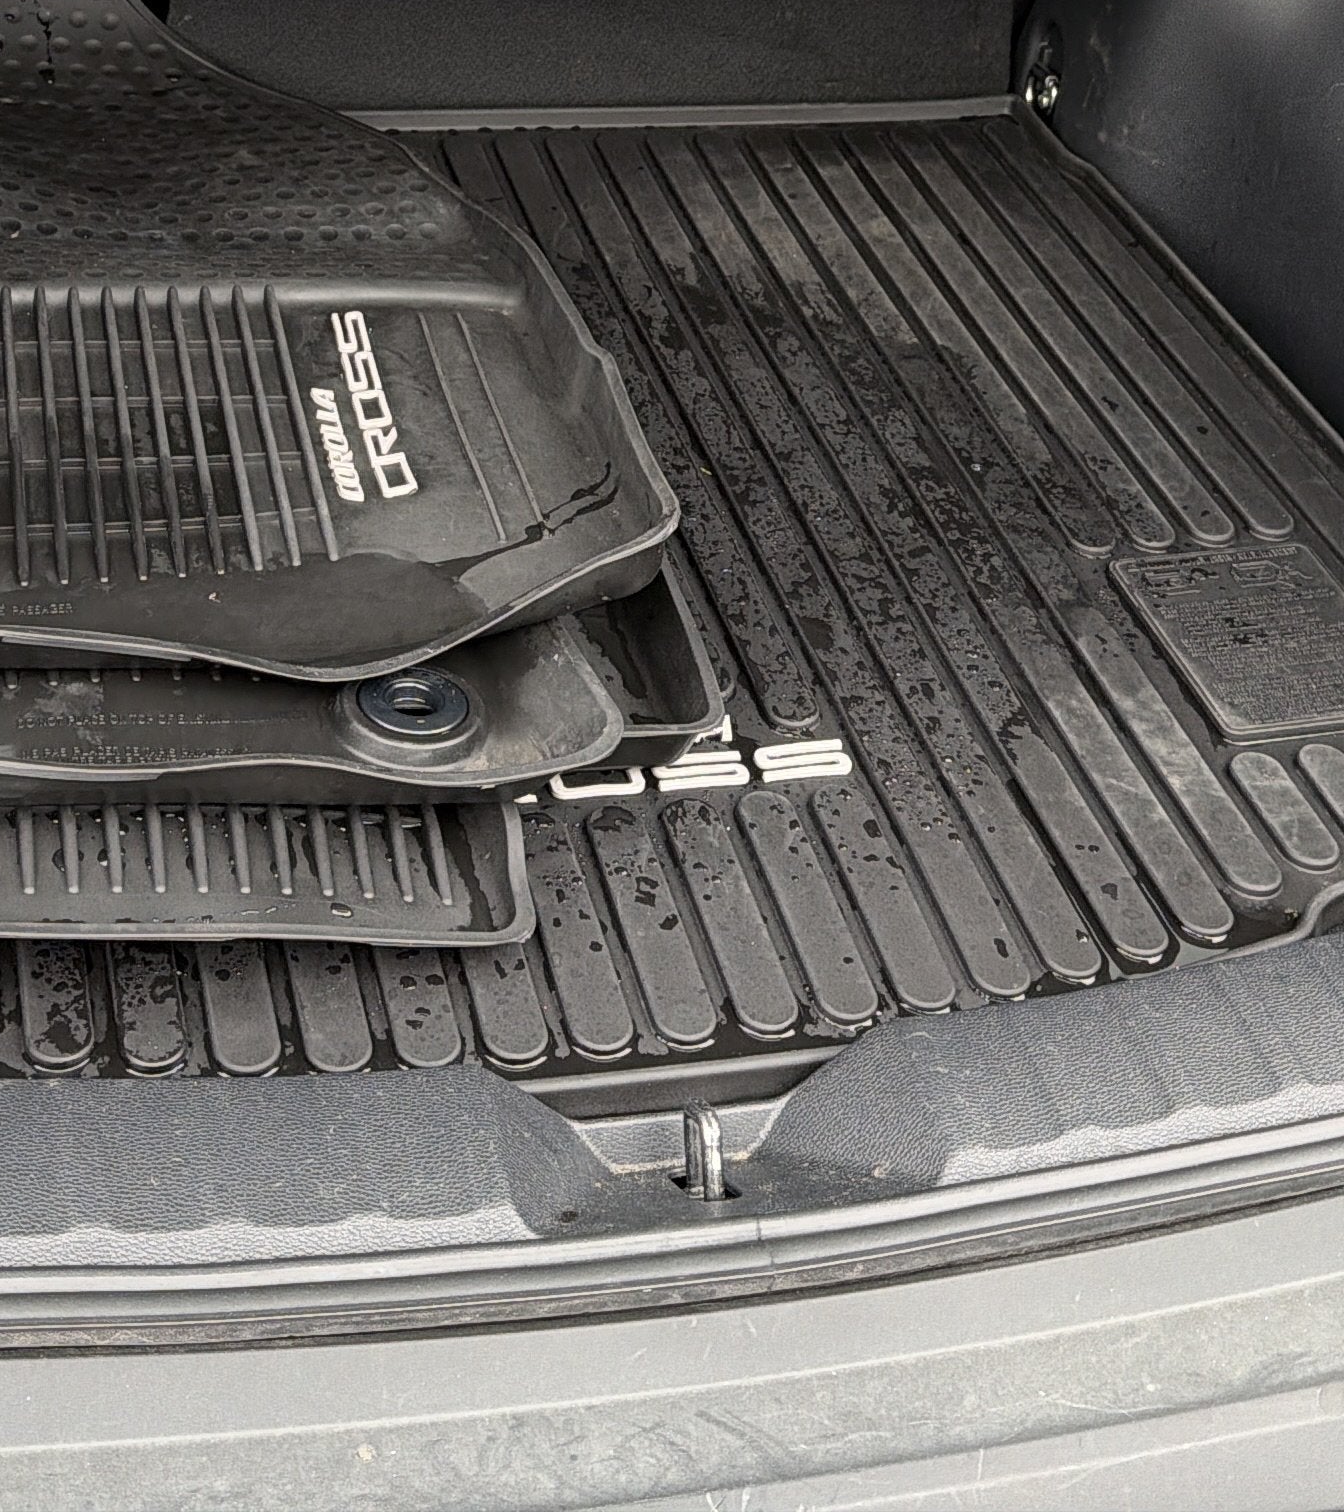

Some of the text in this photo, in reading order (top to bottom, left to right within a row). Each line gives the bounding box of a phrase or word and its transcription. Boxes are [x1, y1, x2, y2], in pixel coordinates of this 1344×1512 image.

[310, 387, 365, 502] COROLLA
[331, 311, 418, 498] CROSS
[12, 602, 73, 615] PASSAGER
[514, 738, 852, 803] OSS
